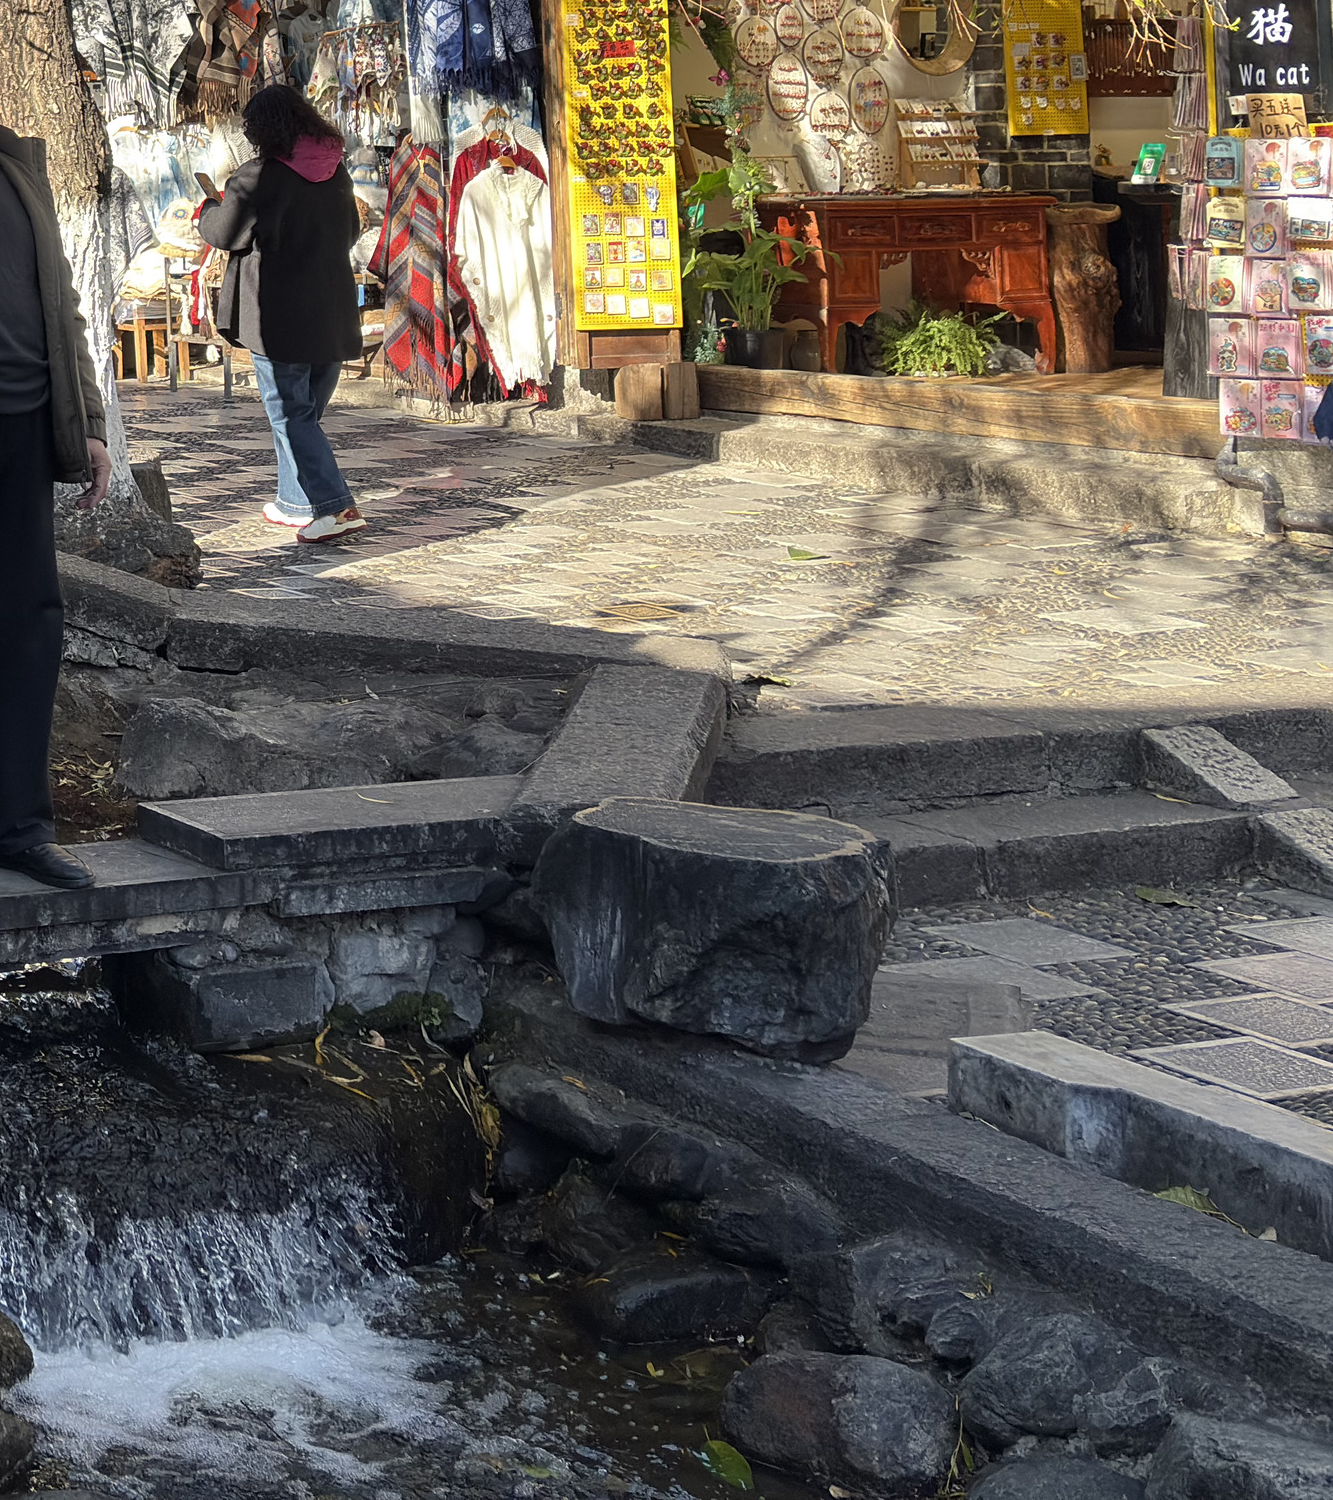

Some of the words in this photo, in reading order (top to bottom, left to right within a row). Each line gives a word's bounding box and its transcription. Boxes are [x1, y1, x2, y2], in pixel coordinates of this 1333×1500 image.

[1238, 63, 1266, 86] Wa
[1276, 63, 1310, 86] cat
[1250, 98, 1303, 118] 买五送一
